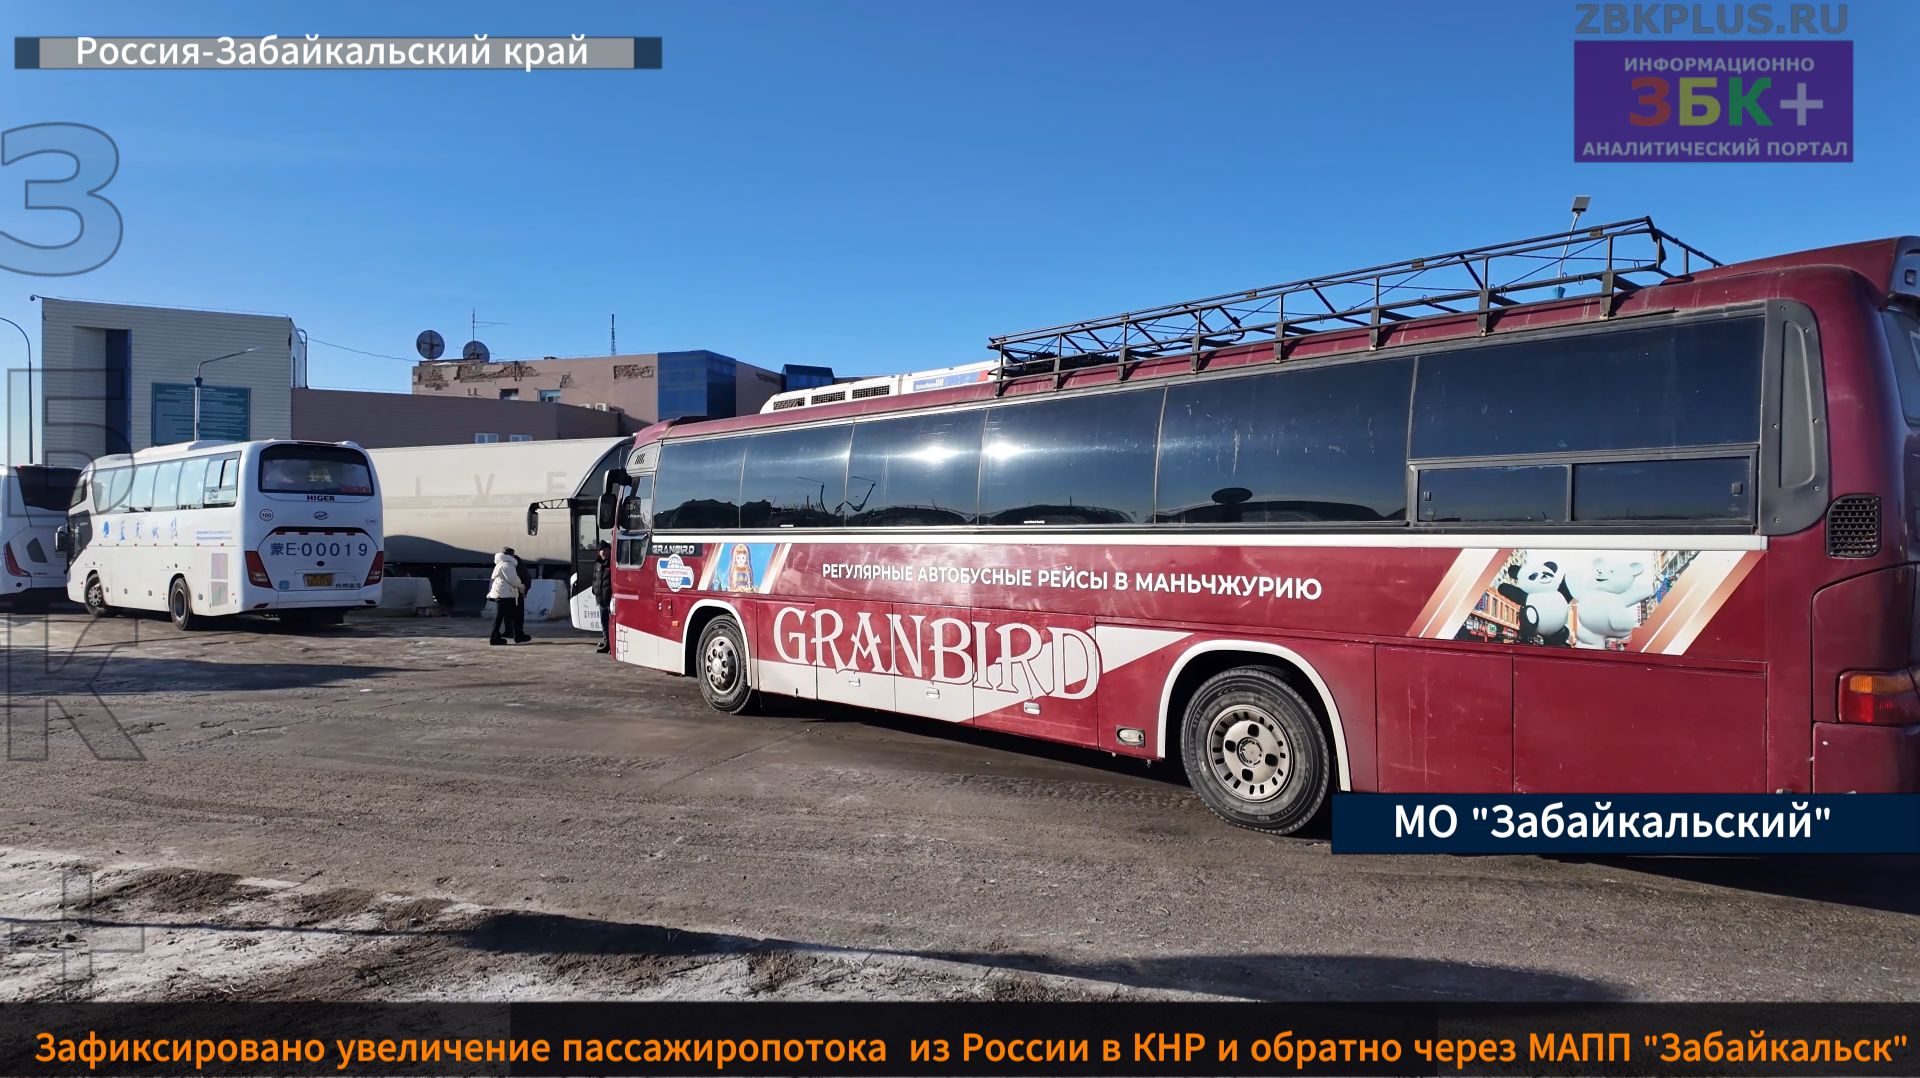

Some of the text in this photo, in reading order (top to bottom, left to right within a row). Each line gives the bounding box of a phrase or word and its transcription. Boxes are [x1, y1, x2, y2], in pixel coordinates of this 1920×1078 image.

[306, 494, 335, 502] HIGER
[822, 563, 1322, 600] РЕГУЛЯРНЫЕ АВТОБУСНЫЕ РЕЙСЫ В МАНЬЧЖУРИЮ
[772, 606, 1102, 700] GRANBIRD
